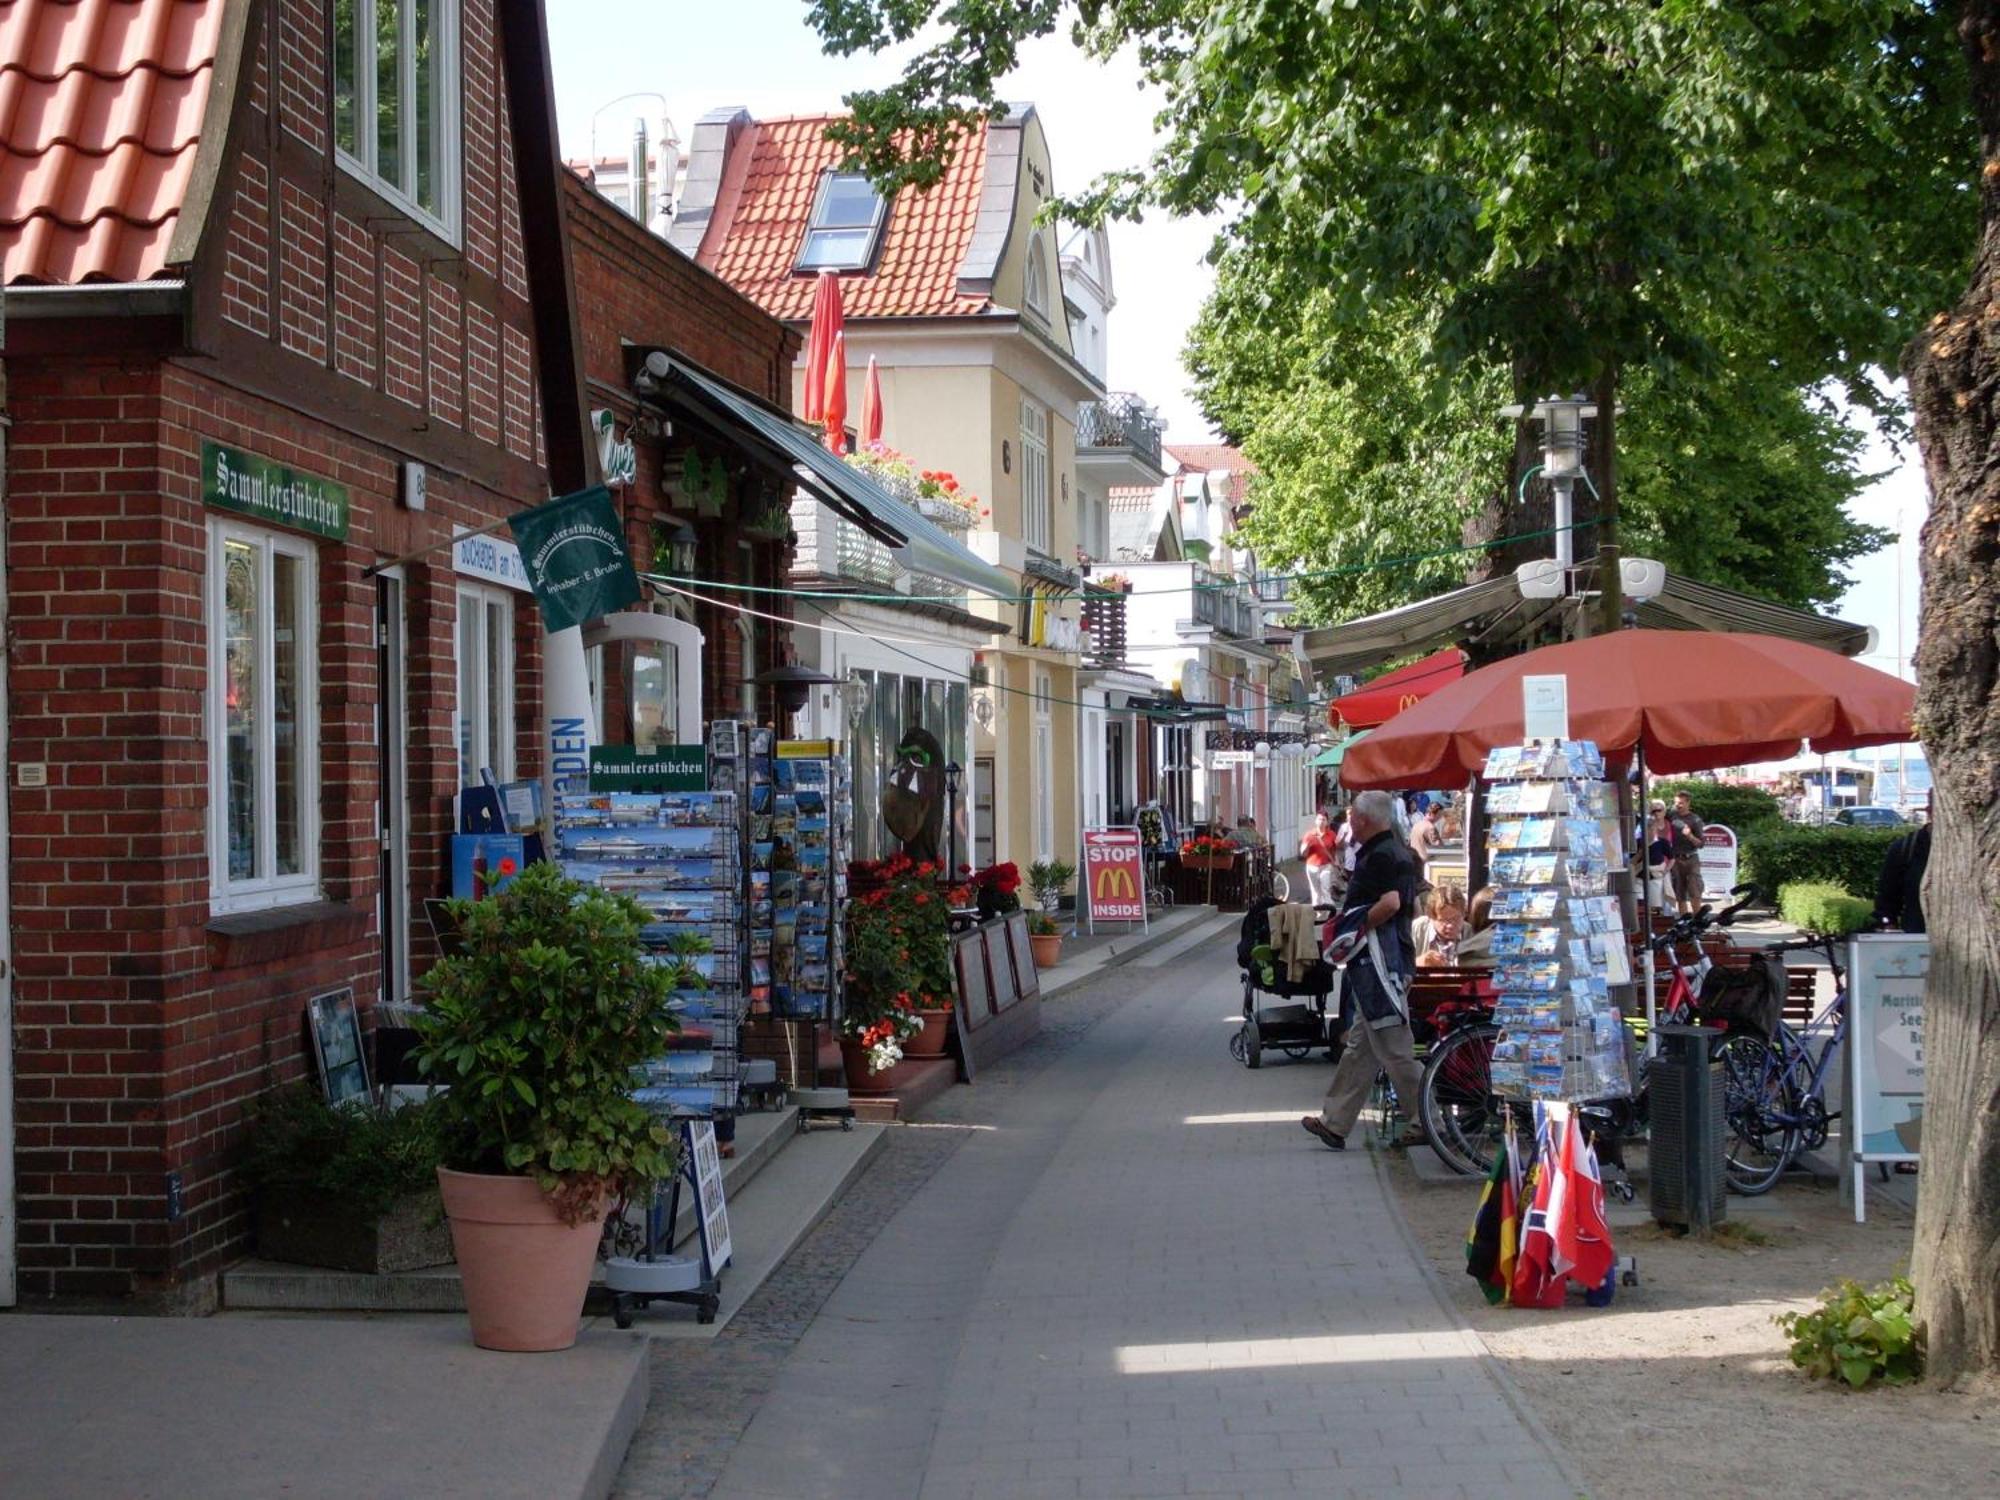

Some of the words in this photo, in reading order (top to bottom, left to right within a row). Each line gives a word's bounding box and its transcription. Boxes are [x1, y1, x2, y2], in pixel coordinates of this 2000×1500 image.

[216, 451, 340, 535] Sammlerstübchen
[592, 760, 703, 776] Sammlerstübchen
[1089, 847, 1137, 863] STOP
[1093, 904, 1142, 916] INSIDE
